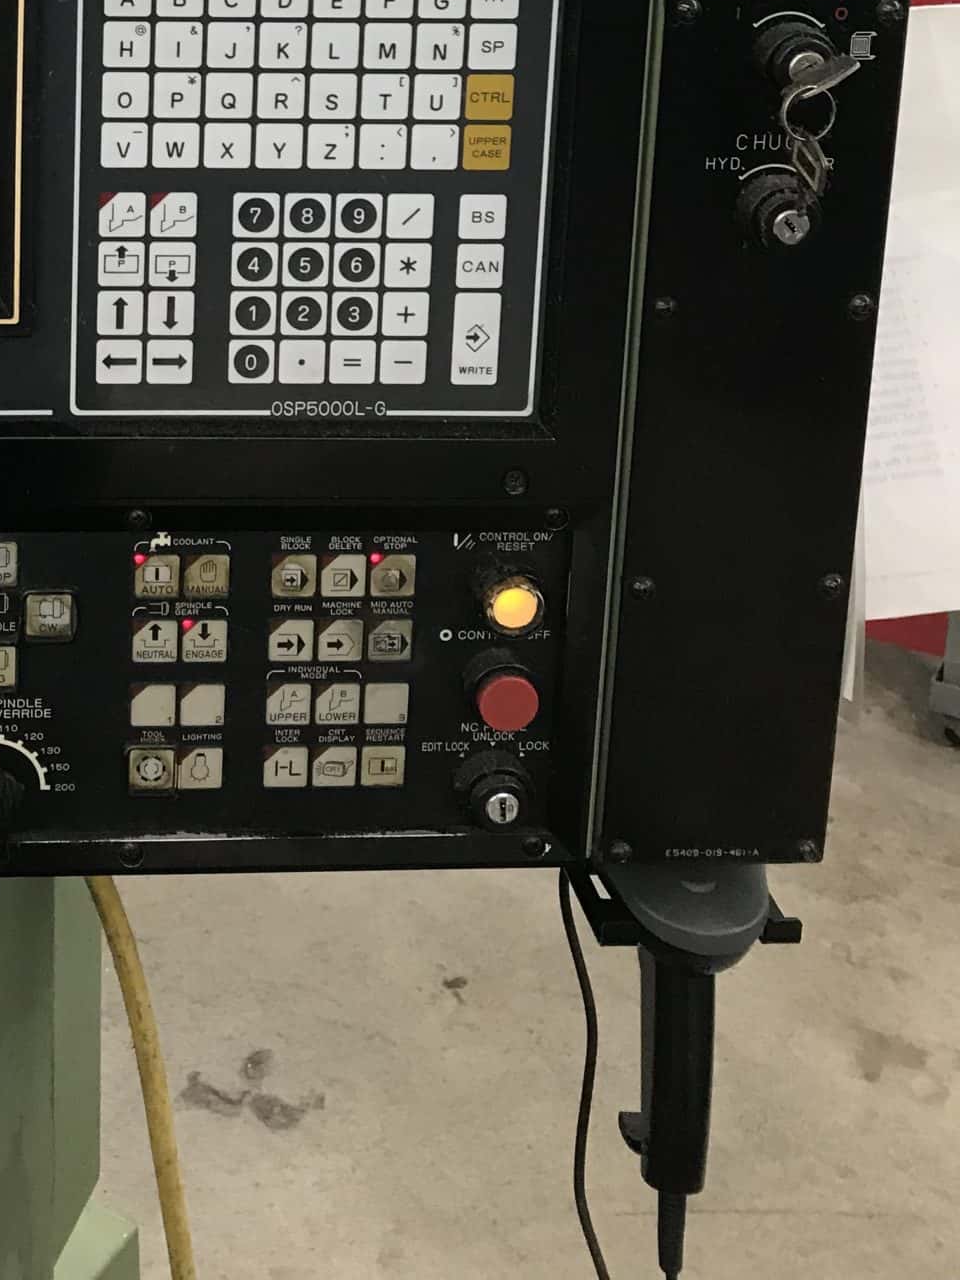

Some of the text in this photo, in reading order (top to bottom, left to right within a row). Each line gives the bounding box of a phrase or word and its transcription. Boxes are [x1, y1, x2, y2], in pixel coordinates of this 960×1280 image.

[120, 41, 133, 57] H
[225, 43, 236, 59] J
[277, 43, 289, 59] K
[329, 43, 340, 59] L
[379, 43, 396, 59] M
[433, 44, 447, 60] N
[481, 41, 504, 53] SP
[171, 92, 183, 108] P
[221, 93, 236, 109] Q
[275, 93, 288, 109] R
[326, 94, 338, 110] S
[379, 94, 392, 110] T
[430, 95, 443, 111] U
[470, 92, 510, 103] CTRL
[469, 137, 506, 145] UPPER
[117, 142, 130, 158] V
[166, 142, 184, 158] W
[221, 143, 233, 159] X
[273, 143, 286, 159] Y
[324, 144, 336, 160] Z
[472, 150, 501, 158] CASE
[705, 157, 746, 171] HYD.
[250, 208, 261, 224] 7
[302, 208, 313, 224] 8
[354, 208, 364, 224] 9
[472, 211, 494, 223] BS
[248, 257, 259, 272] 4
[300, 257, 310, 273] 5
[351, 257, 362, 273] 6
[462, 261, 499, 272] CAN
[249, 306, 256, 321] 1
[298, 305, 309, 321] 2
[348, 306, 359, 322] 3
[459, 367, 492, 375] WRITE
[173, 538, 215, 546] COOLANT
[479, 532, 532, 542] CONTROL
[497, 542, 535, 552] RESET
[142, 585, 173, 594] AUTO
[294, 604, 313, 612] RUN
[322, 601, 362, 609] MACHINE
[40, 624, 57, 633] CW
[136, 650, 176, 659] NEUTRAL
[185, 650, 224, 659] ENGAGE
[269, 713, 307, 721] UPPER
[319, 712, 356, 721] LOWER
[461, 722, 479, 732] NC
[182, 733, 222, 741] LIGHTING
[473, 733, 515, 741] UNLOCK
[421, 742, 470, 752] EDIT LOCK
[519, 741, 550, 750] LOCK
